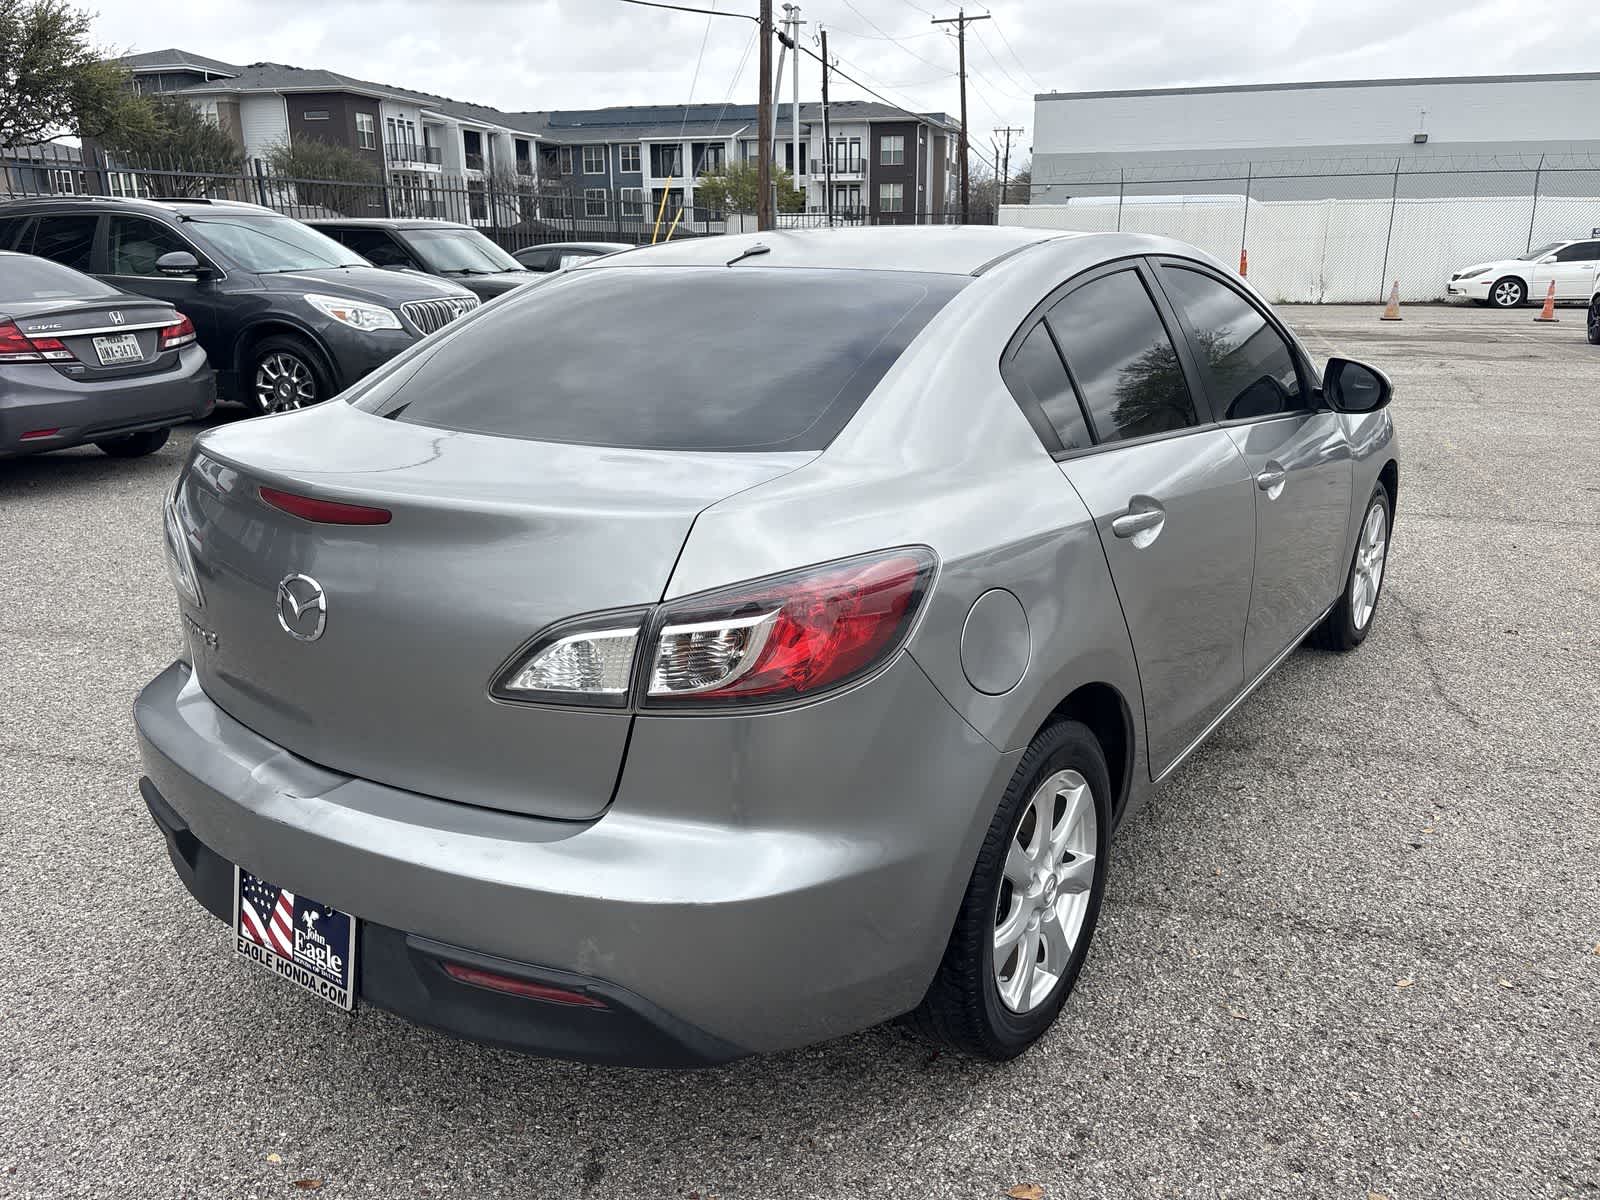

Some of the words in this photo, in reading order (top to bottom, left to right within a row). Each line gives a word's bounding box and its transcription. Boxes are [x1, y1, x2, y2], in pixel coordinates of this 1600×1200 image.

[294, 927, 342, 972] Eagle
[306, 928, 325, 946] John
[237, 937, 273, 969] EAGLE
[276, 958, 348, 1009] HONDA.COM
